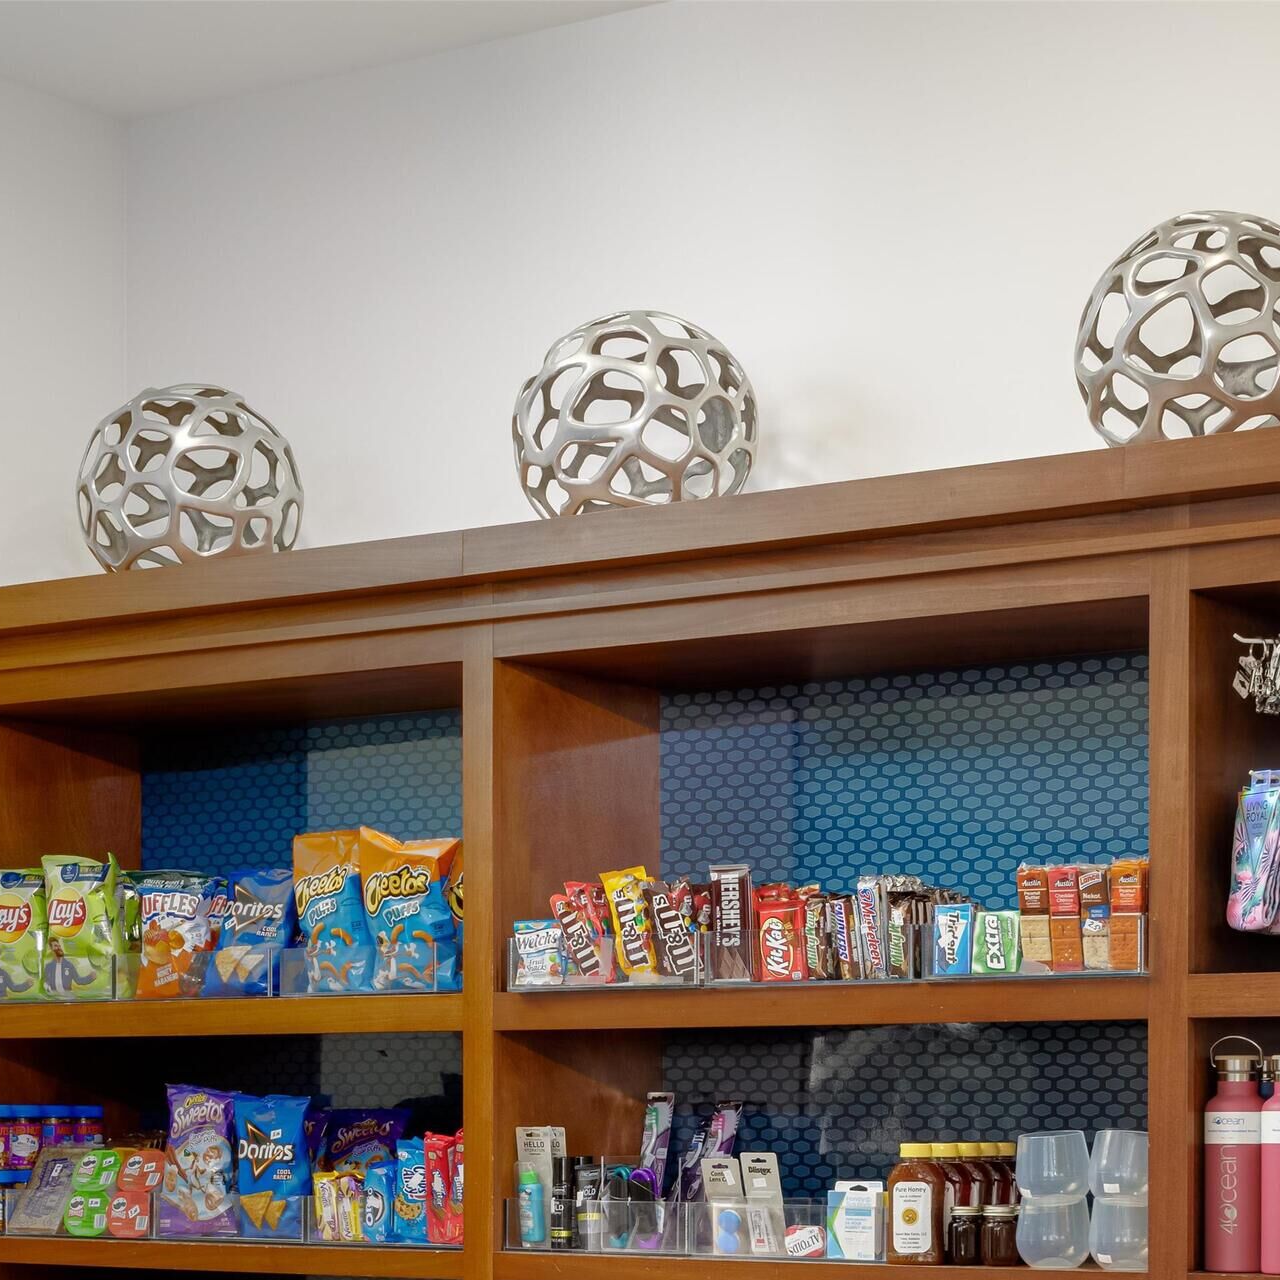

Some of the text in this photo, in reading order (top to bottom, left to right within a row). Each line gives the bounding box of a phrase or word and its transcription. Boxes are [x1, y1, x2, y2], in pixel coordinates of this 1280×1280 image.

[1246, 800, 1268, 811] LIVING
[1246, 812, 1267, 822] ROYAL
[295, 867, 346, 916] Cheetos
[366, 867, 430, 915] Cheetos
[49, 898, 85, 927] Lay's
[721, 872, 740, 947] HERSHEY'S
[171, 1100, 224, 1138] Sweetos
[239, 1140, 293, 1160] Doritos
